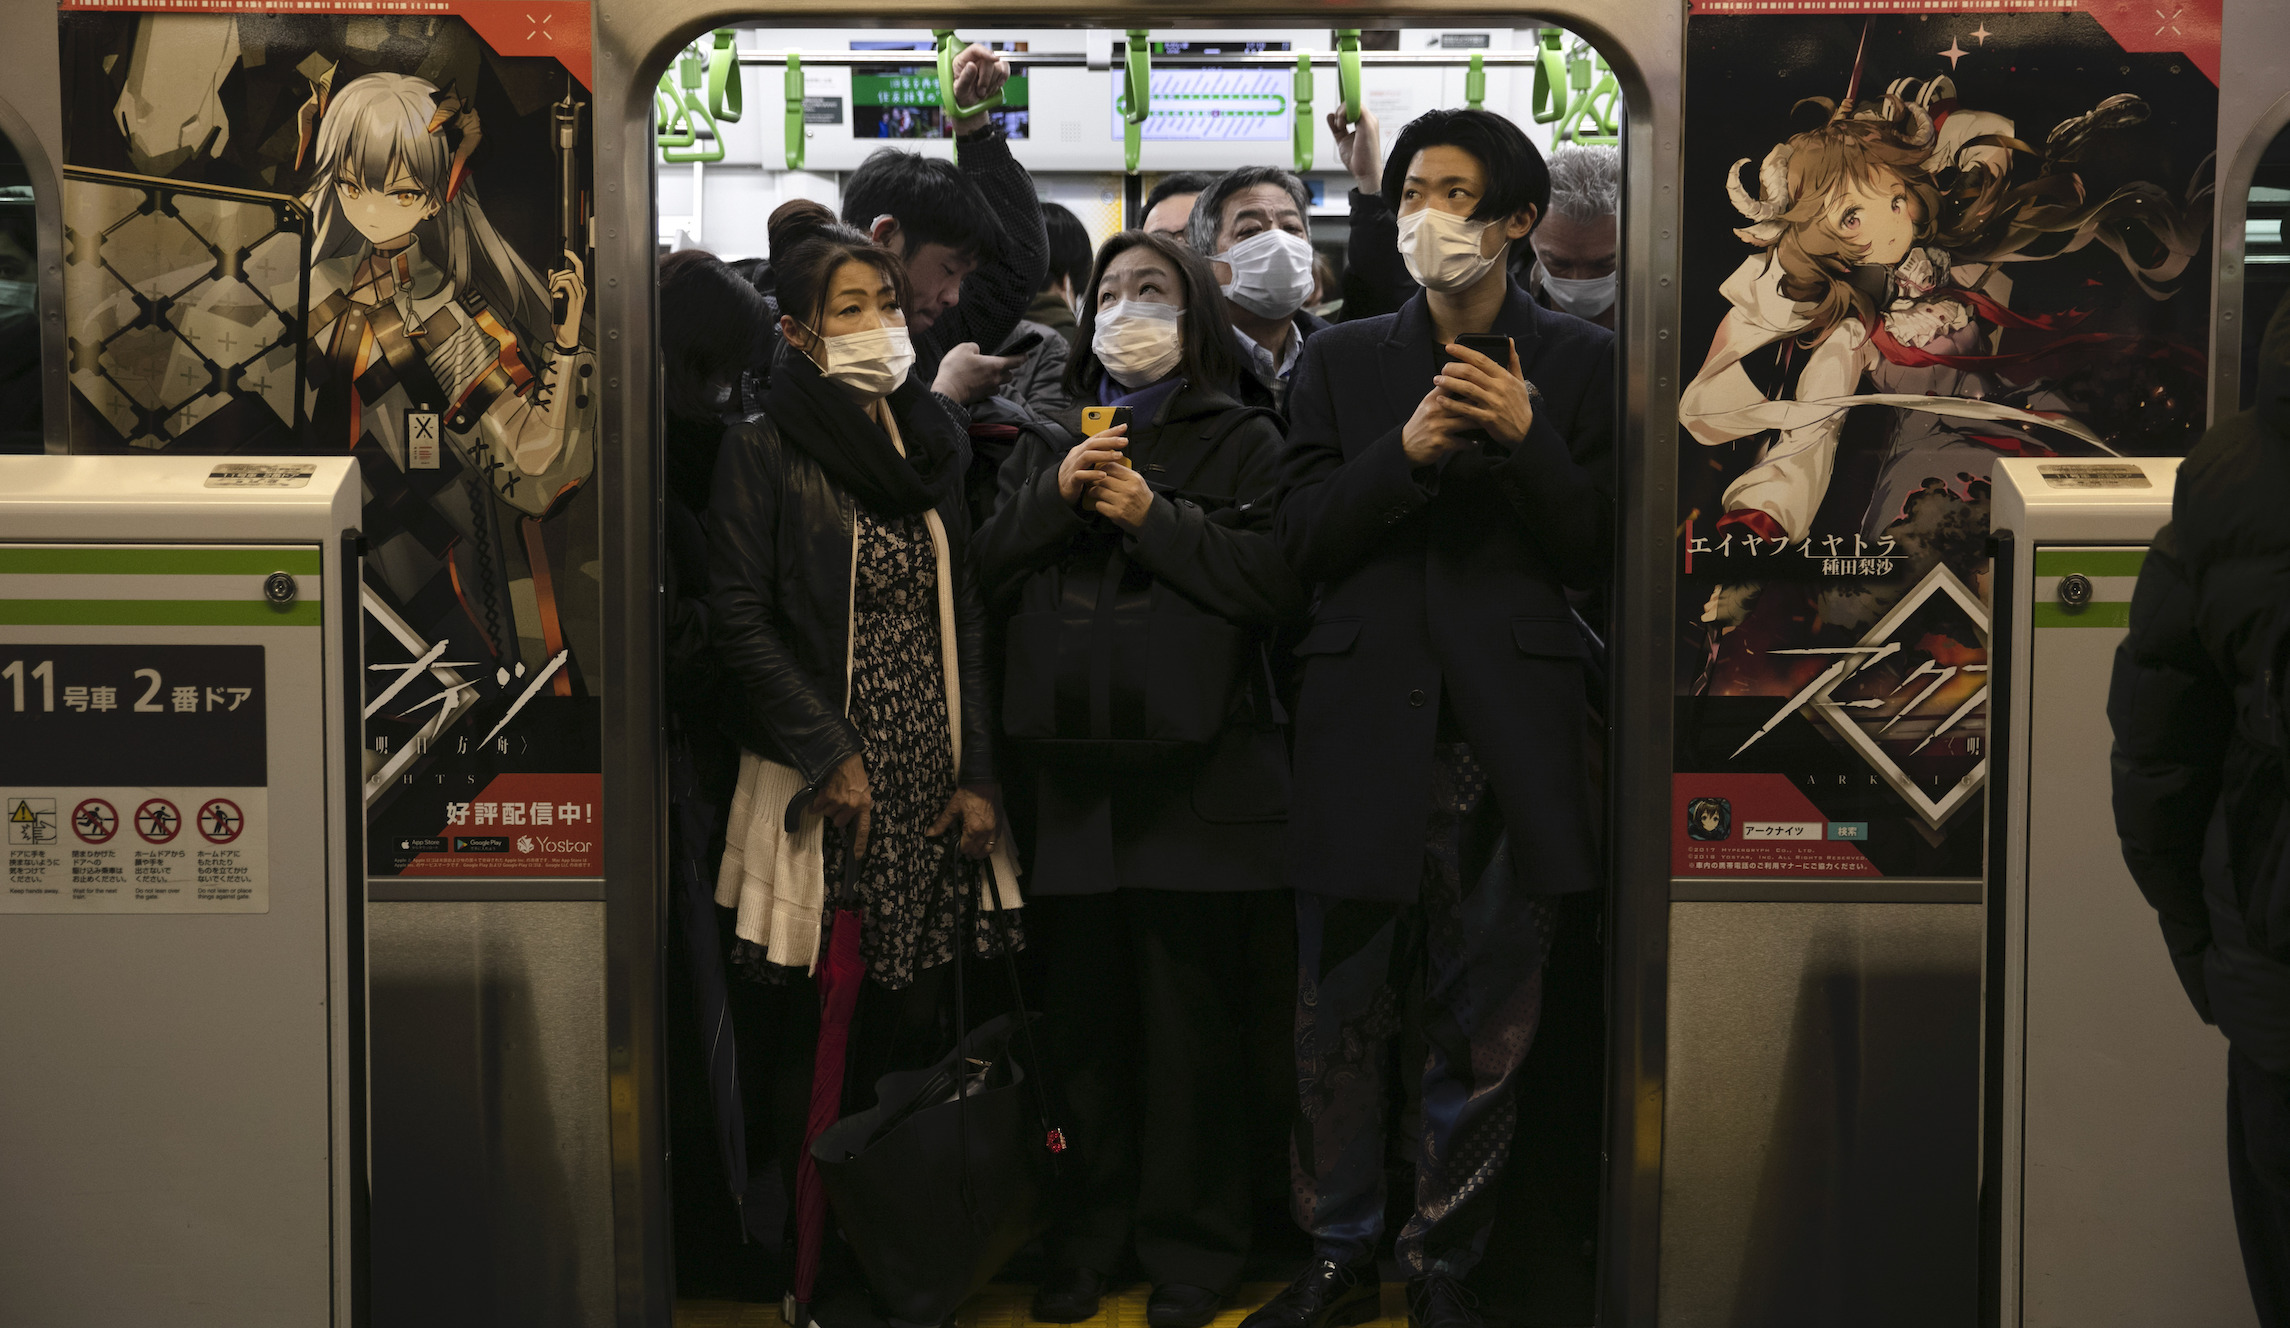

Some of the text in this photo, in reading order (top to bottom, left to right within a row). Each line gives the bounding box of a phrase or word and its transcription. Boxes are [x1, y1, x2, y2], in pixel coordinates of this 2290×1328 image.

[1821, 558, 1894, 576] 種田梨沙
[1745, 826, 1804, 836] アークナイツ
[1837, 826, 1858, 837] 検索
[536, 836, 592, 853] Yostar
